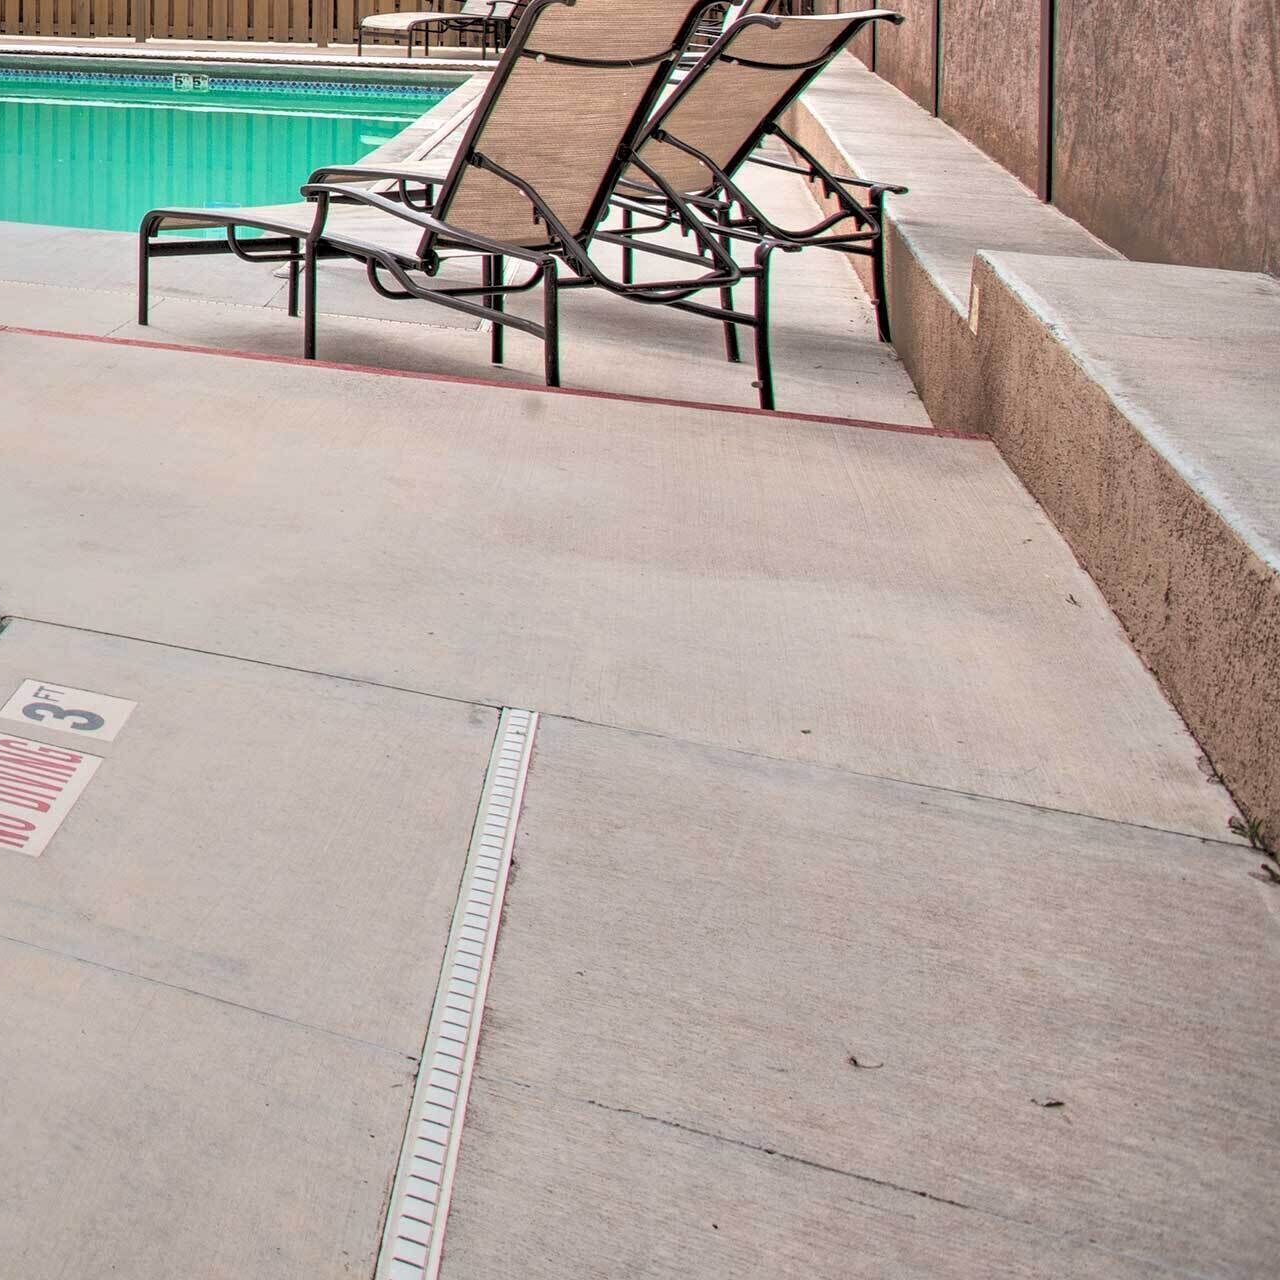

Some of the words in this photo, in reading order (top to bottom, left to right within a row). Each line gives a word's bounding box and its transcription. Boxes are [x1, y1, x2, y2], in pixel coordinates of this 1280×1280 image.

[192, 76, 201, 90] 5
[32, 685, 65, 702] FT
[22, 701, 105, 731] 3
